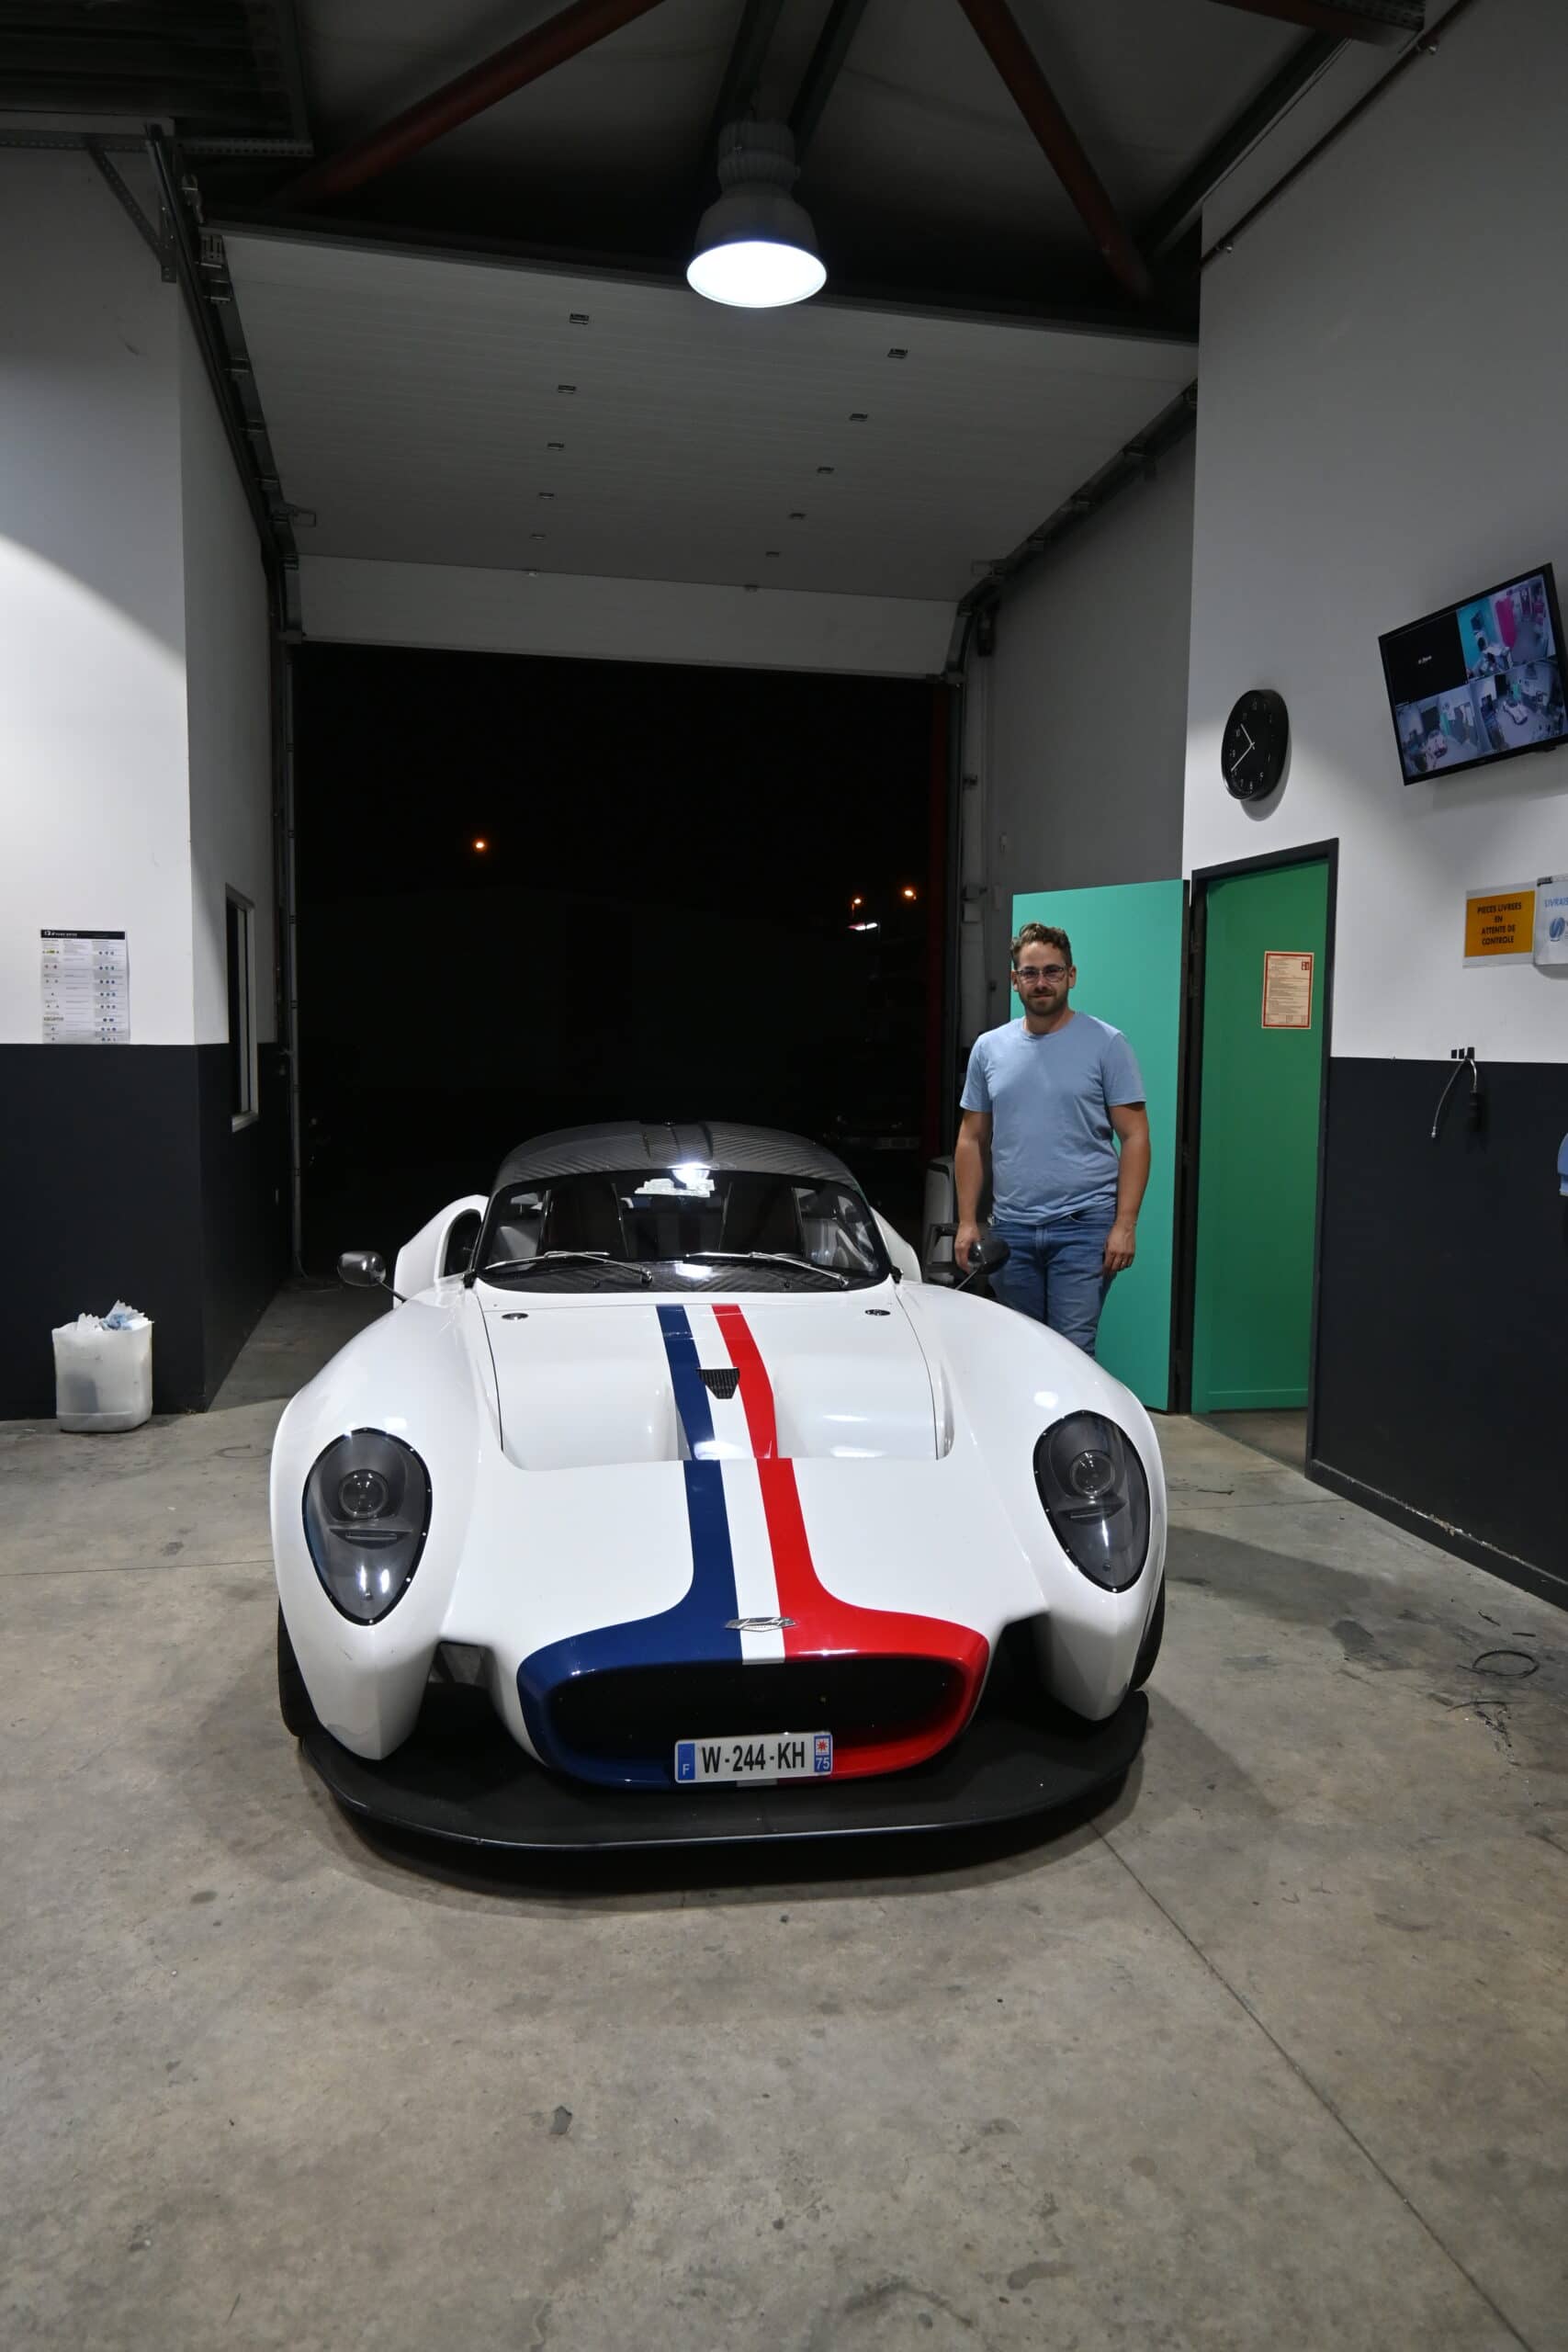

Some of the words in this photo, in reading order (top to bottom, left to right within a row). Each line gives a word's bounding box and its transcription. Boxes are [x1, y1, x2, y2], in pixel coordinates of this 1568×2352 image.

[1482, 926, 1506, 934] ATTENTE
[1507, 924, 1516, 933] DE
[1482, 935, 1515, 945] CONTROLE
[816, 1757, 830, 1770] 75
[682, 1763, 690, 1776] F
